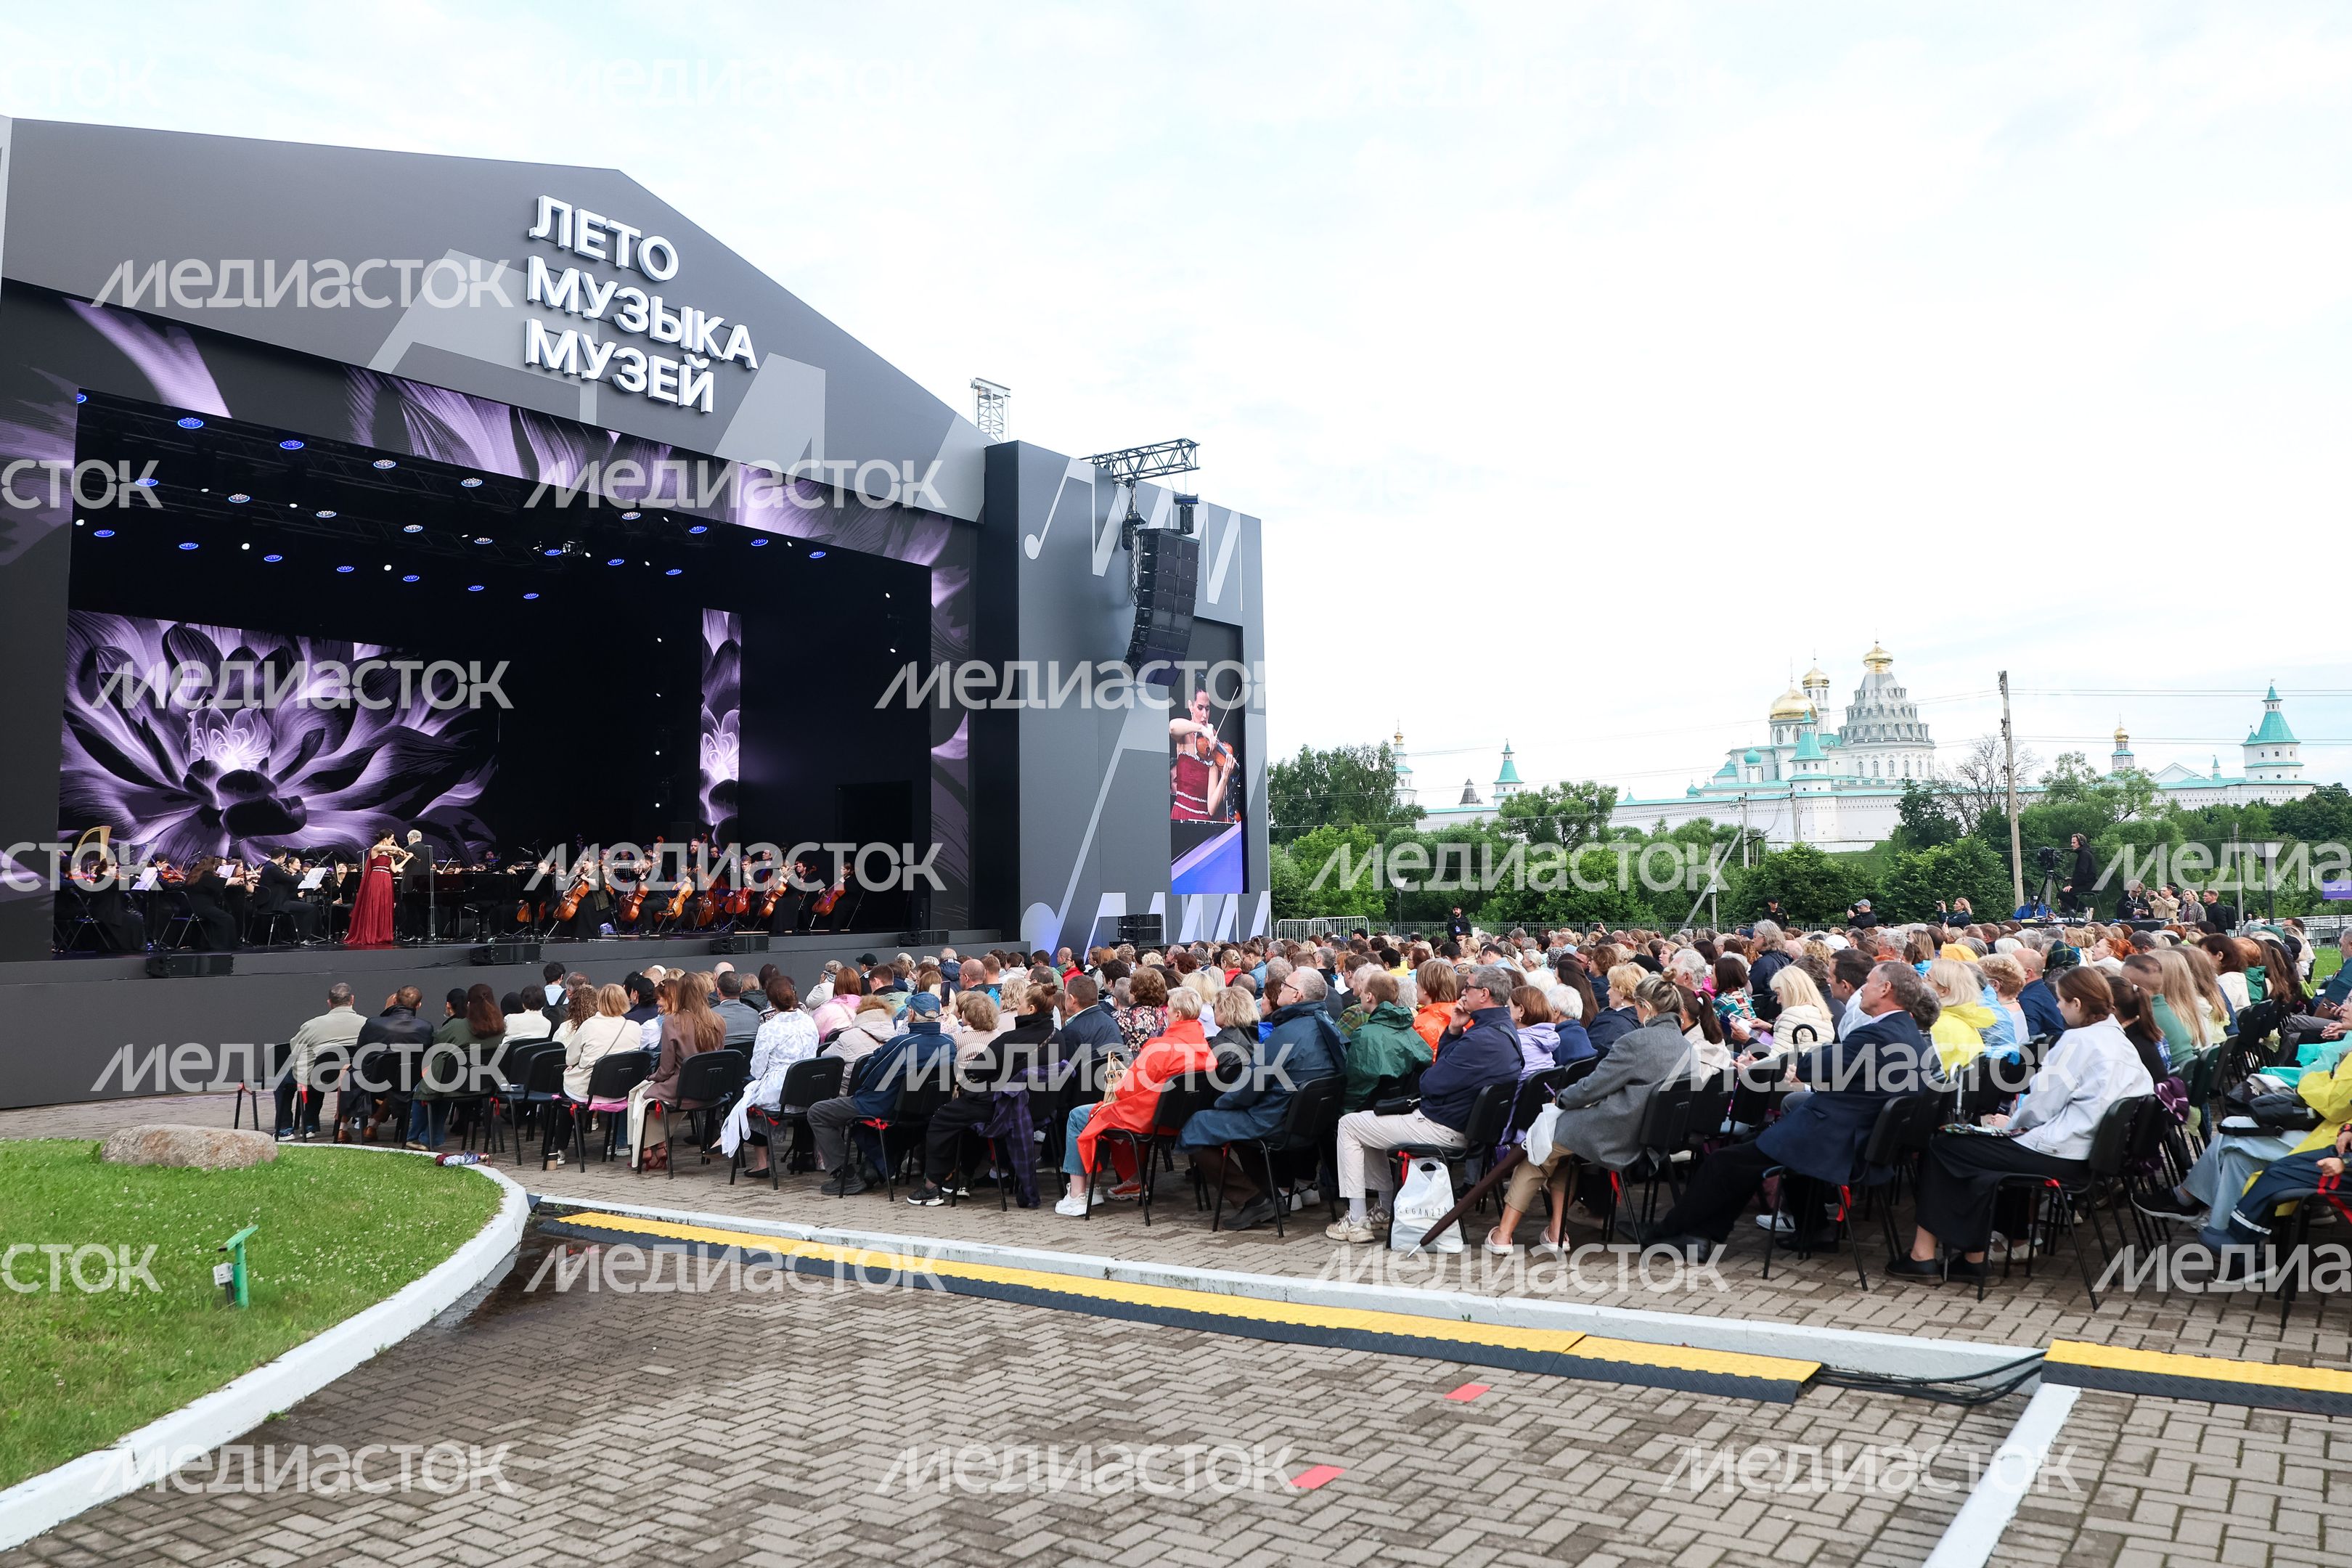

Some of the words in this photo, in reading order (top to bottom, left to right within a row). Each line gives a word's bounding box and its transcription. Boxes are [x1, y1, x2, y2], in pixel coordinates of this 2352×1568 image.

[528, 195, 679, 282] ЛЕТО
[526, 255, 759, 369] МУЗЫКА
[525, 318, 714, 413] МУЗЕЙ
